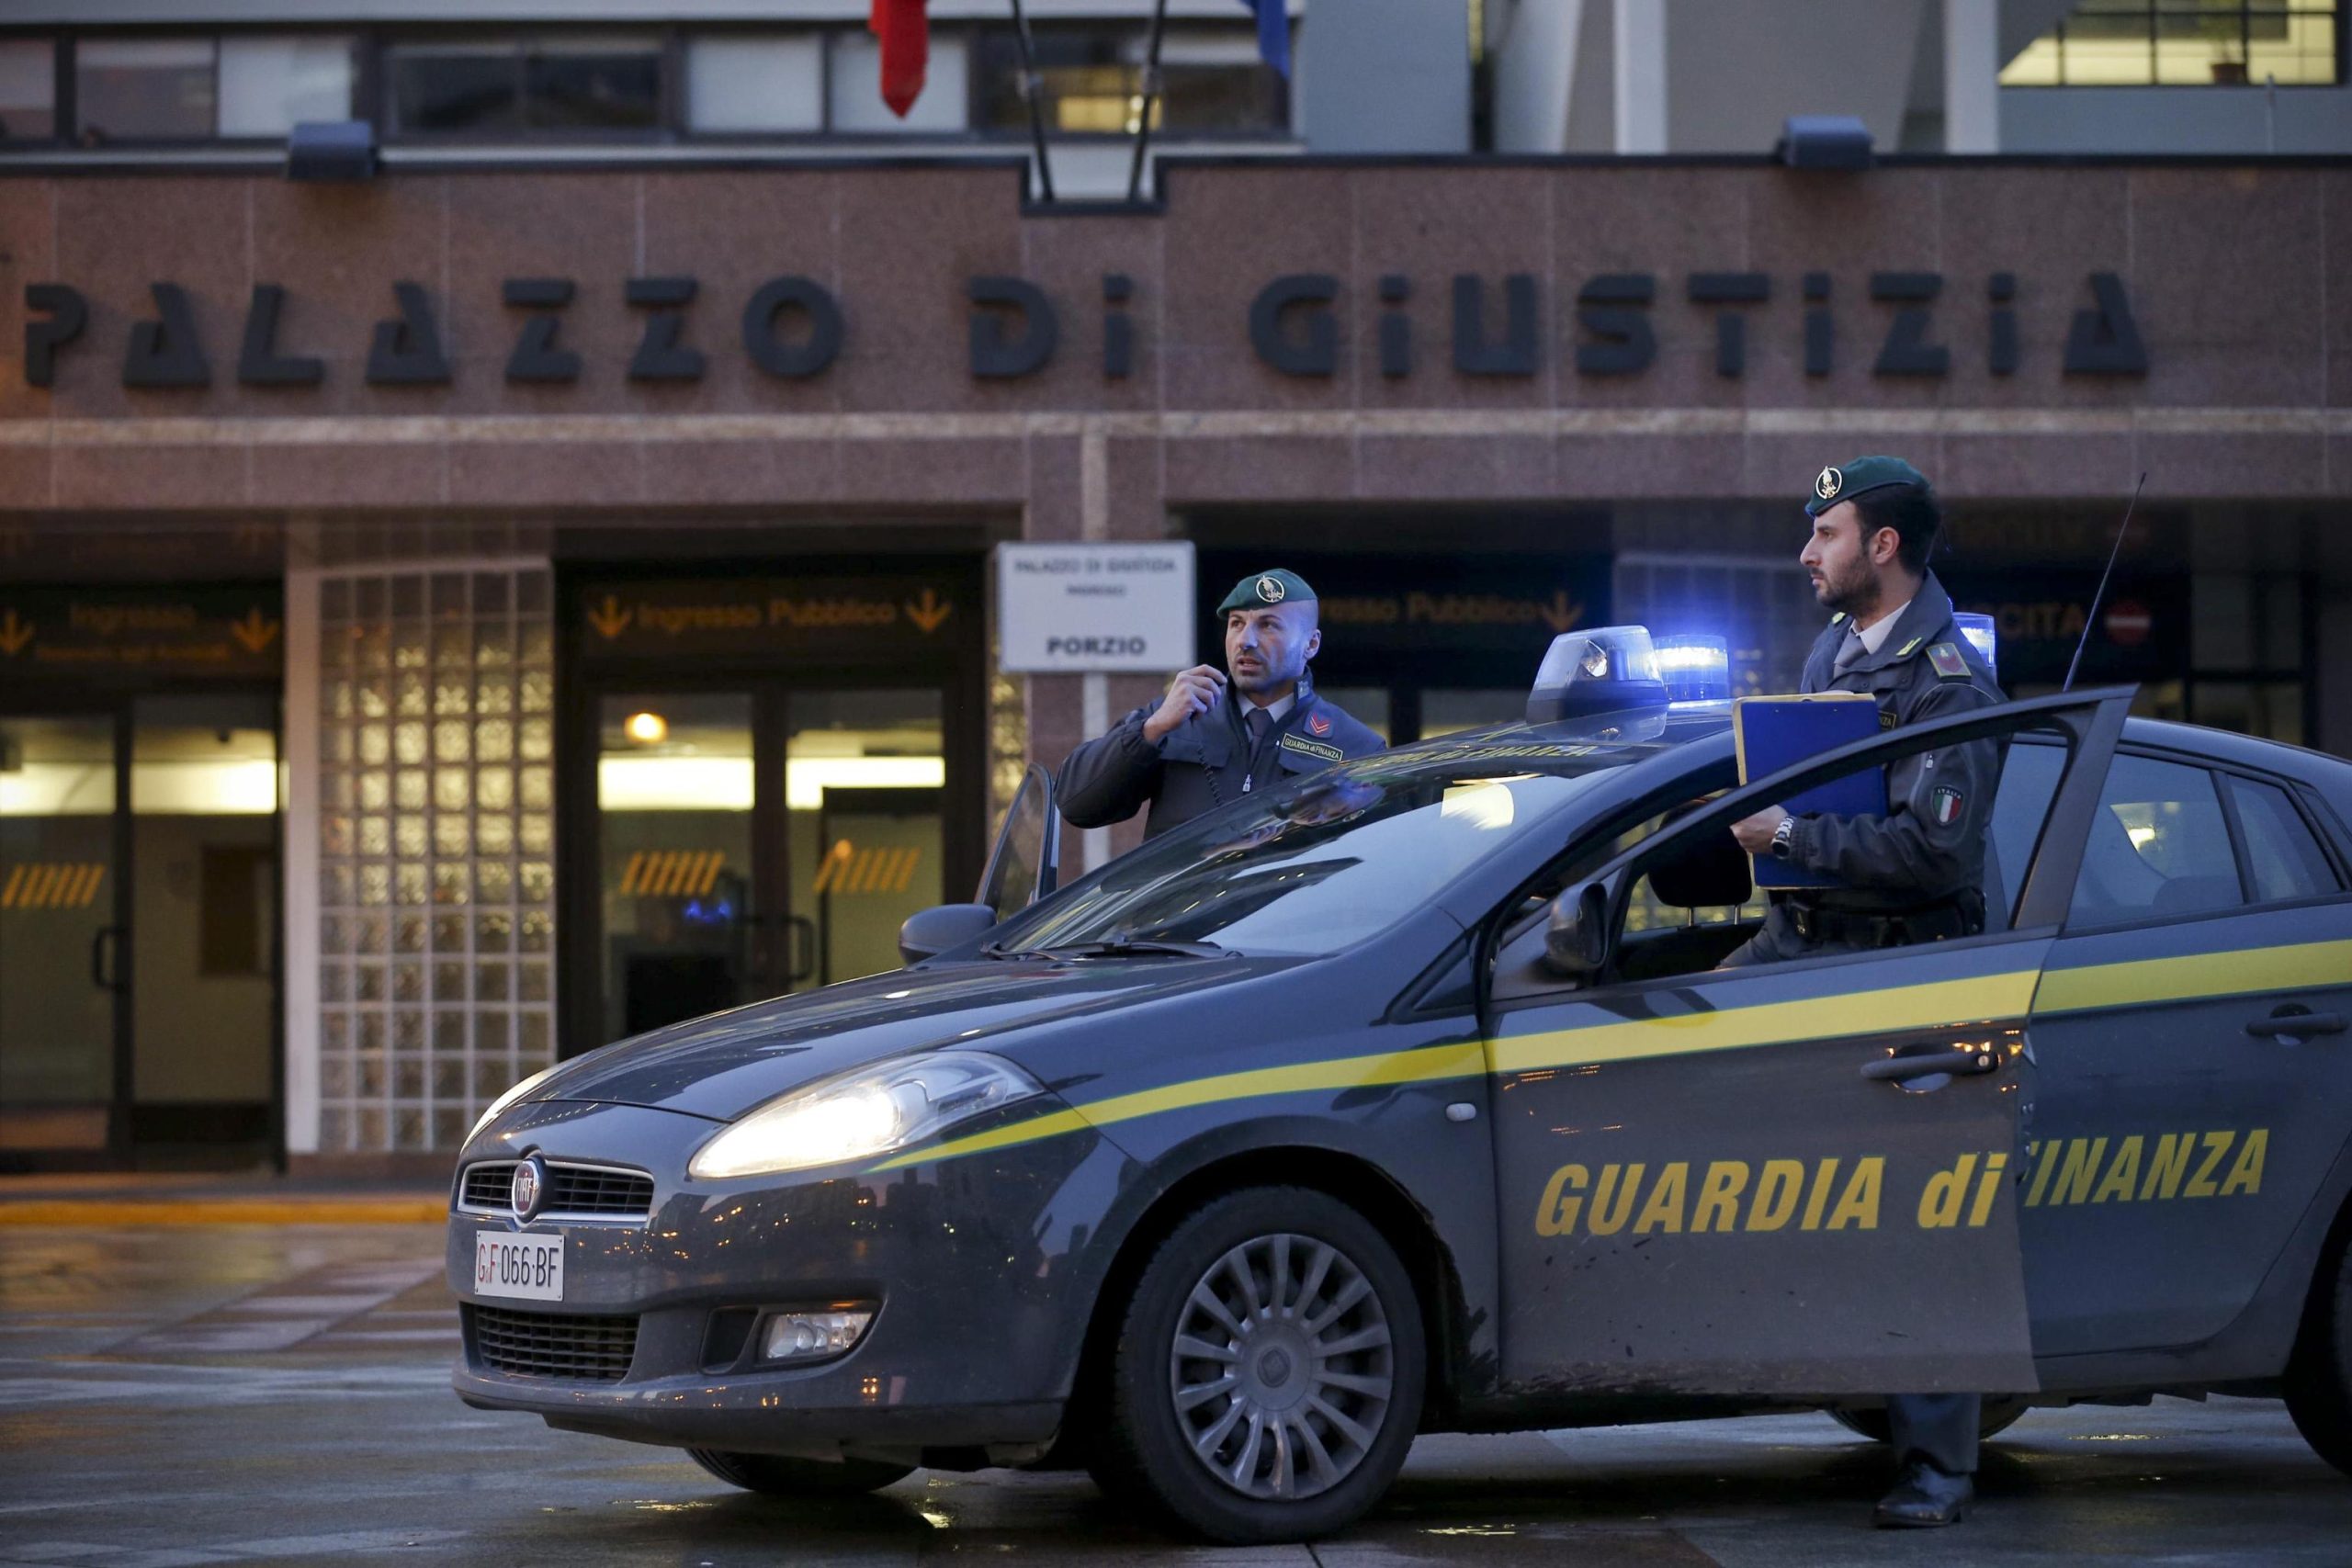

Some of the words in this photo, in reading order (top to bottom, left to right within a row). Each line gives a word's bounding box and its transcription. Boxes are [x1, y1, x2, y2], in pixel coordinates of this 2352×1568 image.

[24, 276, 844, 389] PALAZZO
[1249, 270, 2148, 379] GIUSTIZIA
[1046, 637, 1148, 657] PORZIO
[1284, 738, 1310, 750] GUARDIA
[1315, 745, 1340, 760] FINANZA
[1938, 787, 1962, 799] ITALIA
[516, 1177, 534, 1202] FIAT
[1534, 1157, 1885, 1237] GUARDIA
[1917, 1153, 2008, 1231] di
[2022, 1129, 2269, 1208] INANZA
